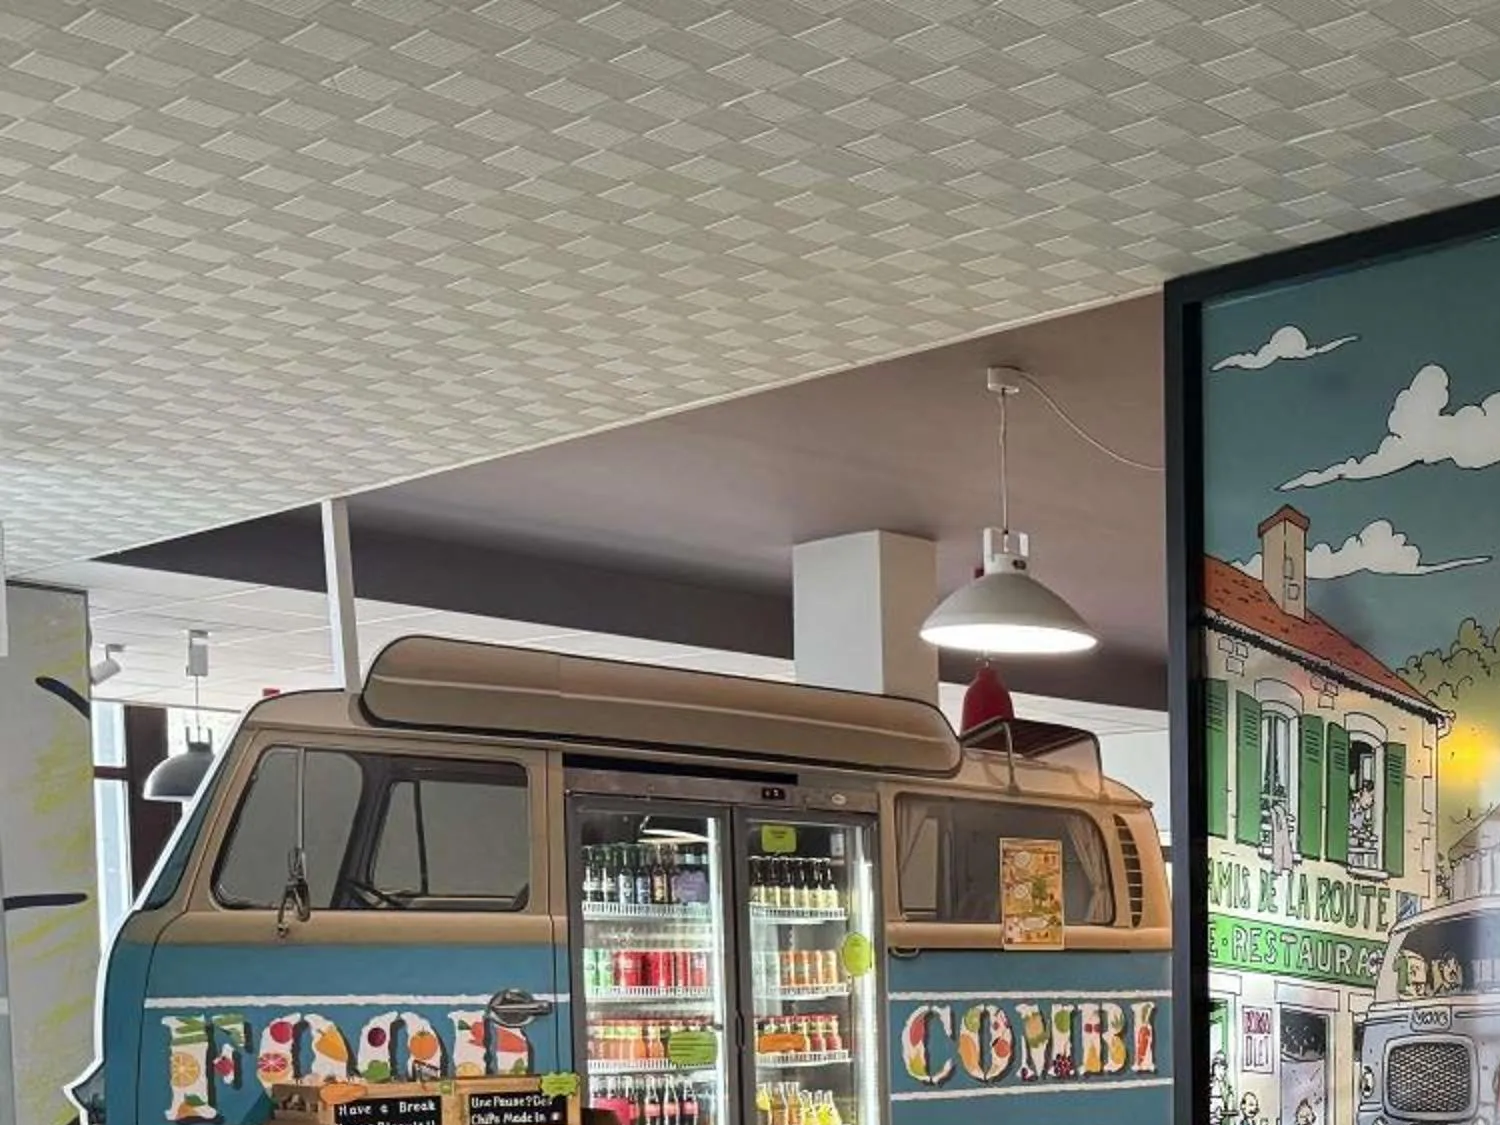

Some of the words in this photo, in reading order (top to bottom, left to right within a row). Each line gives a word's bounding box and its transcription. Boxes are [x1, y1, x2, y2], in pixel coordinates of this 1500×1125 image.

[1286, 870, 1310, 920] LA
[1315, 877, 1391, 932] ROUTE
[1231, 924, 1382, 977] RESTAURA
[901, 1002, 1156, 1084] COMBI
[399, 1099, 437, 1113] Break
